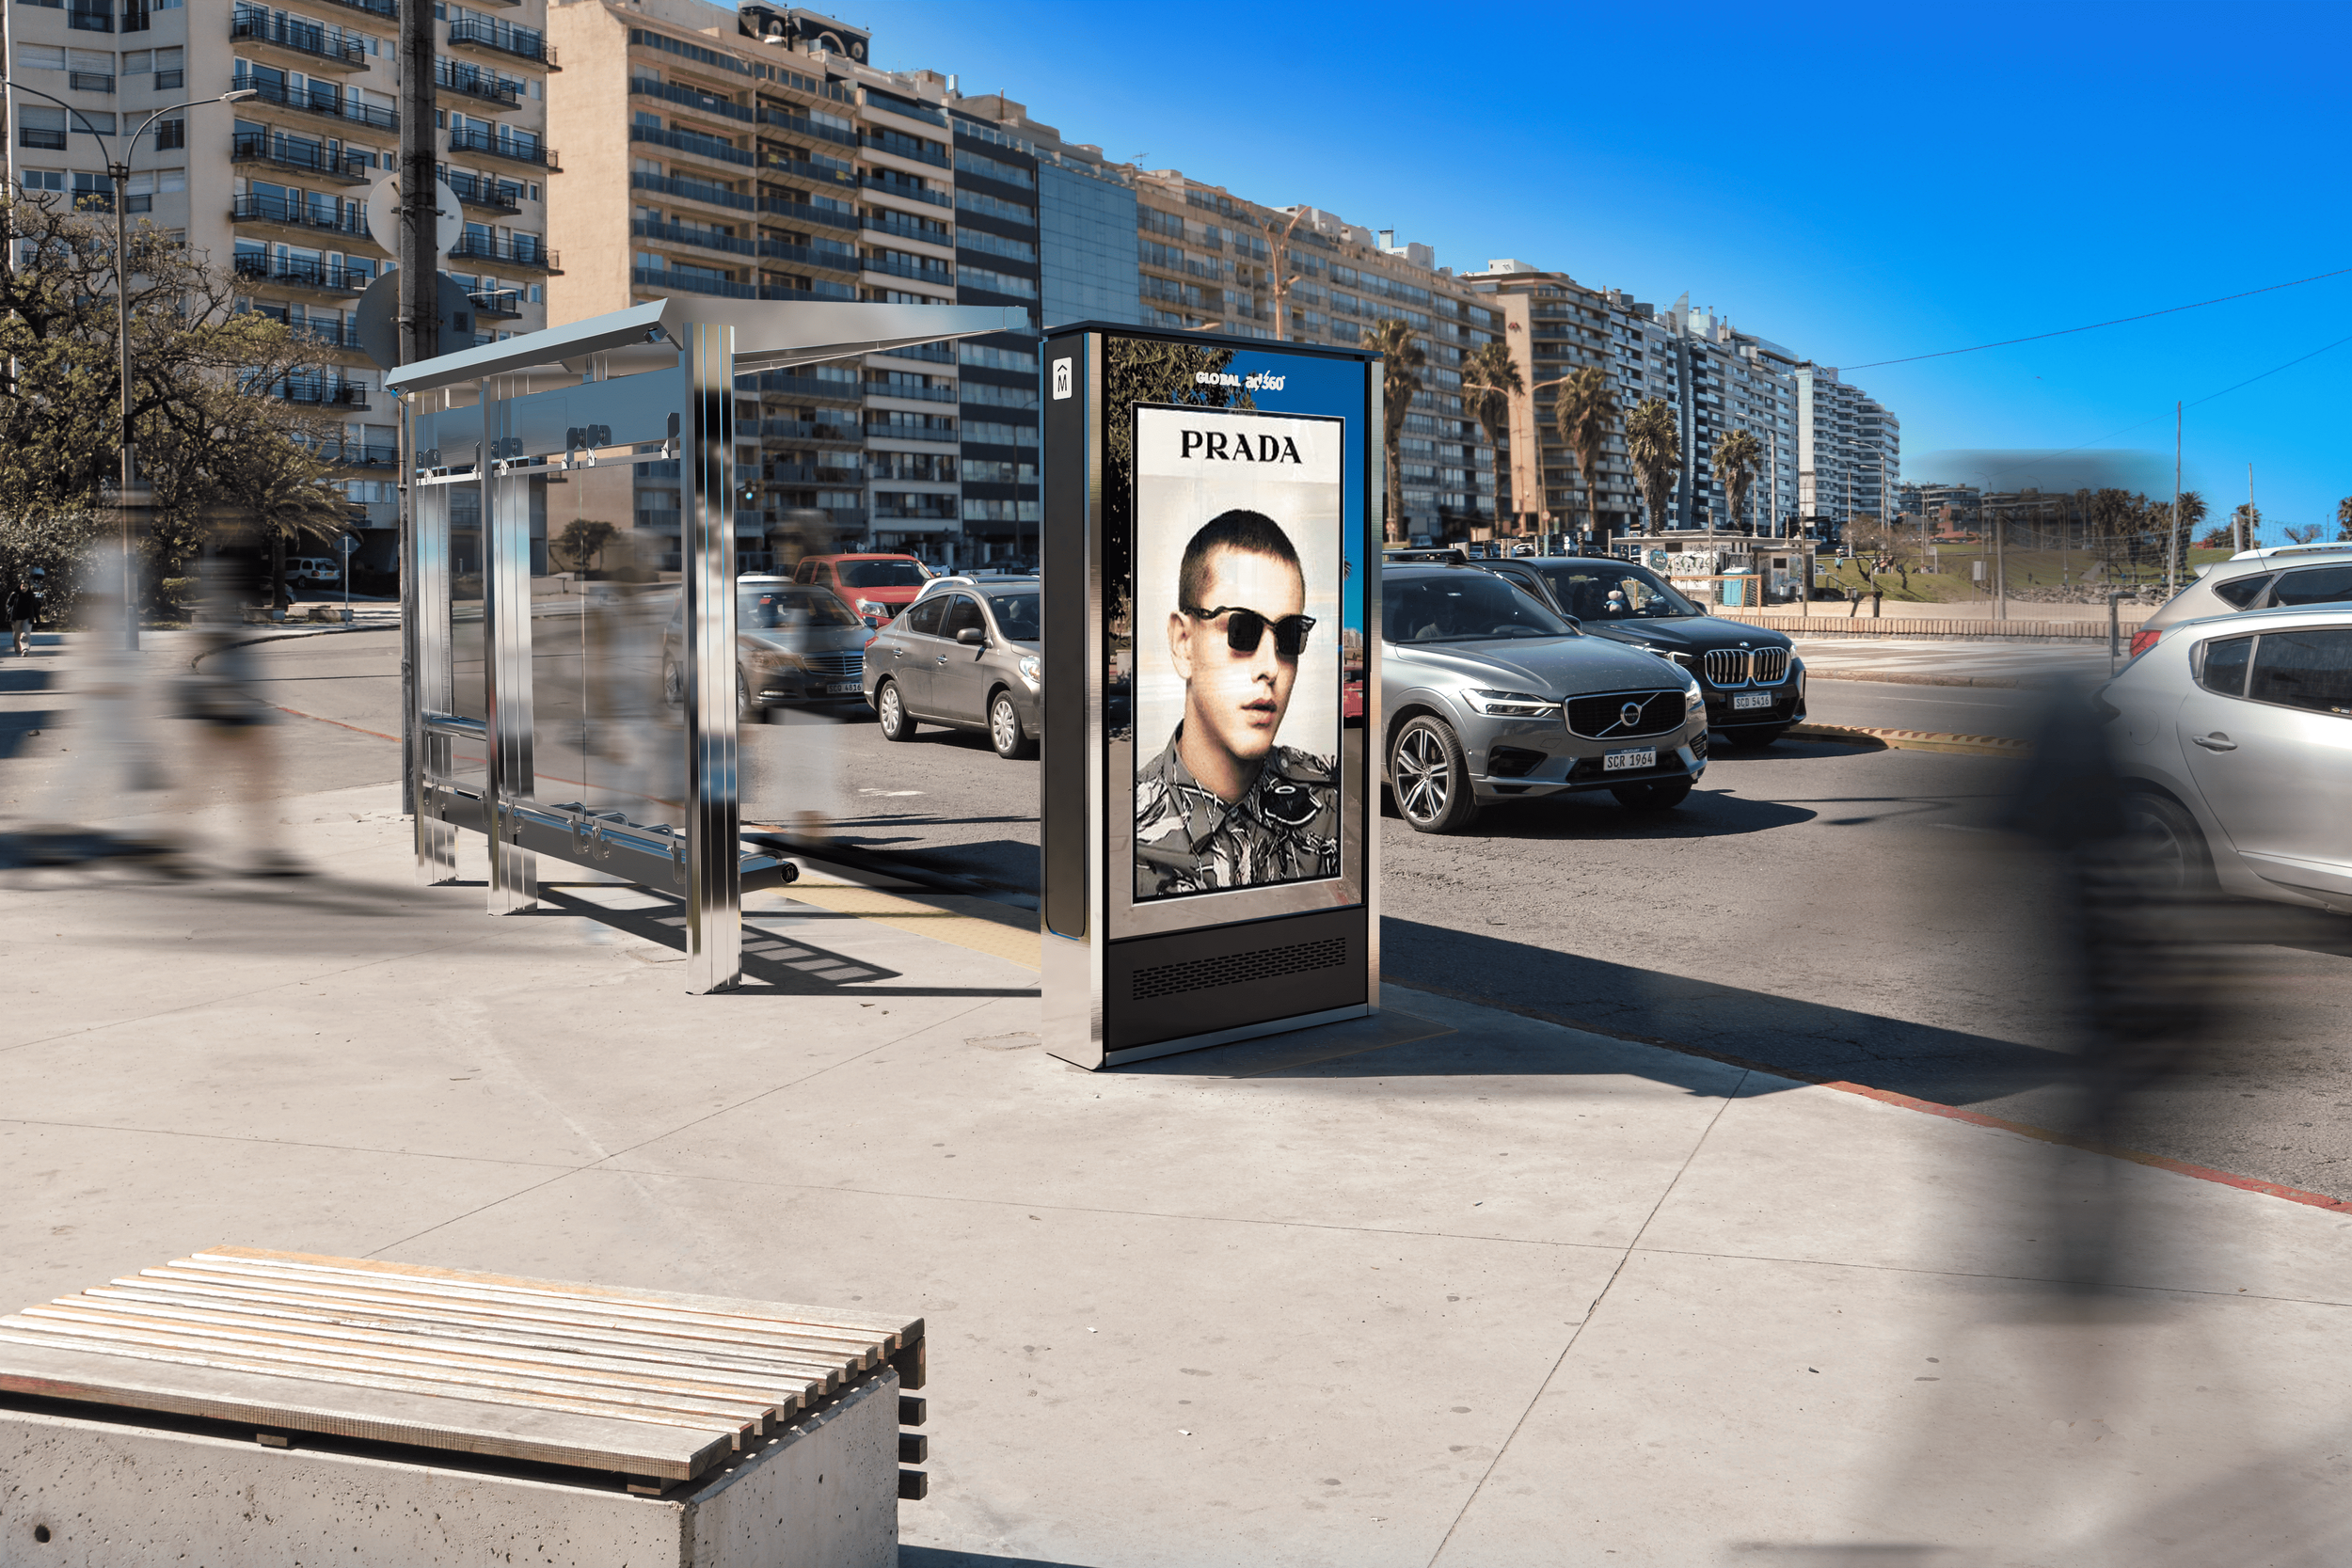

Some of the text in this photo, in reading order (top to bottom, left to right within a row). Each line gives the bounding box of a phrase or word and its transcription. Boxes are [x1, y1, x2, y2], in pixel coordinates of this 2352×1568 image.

[1196, 372, 1241, 387] GLOBAL
[1181, 429, 1303, 464] PRADA
[845, 684, 862, 692] 4816
[1736, 696, 1770, 708] SCD 5416
[1607, 752, 1653, 768] SCR 1964
